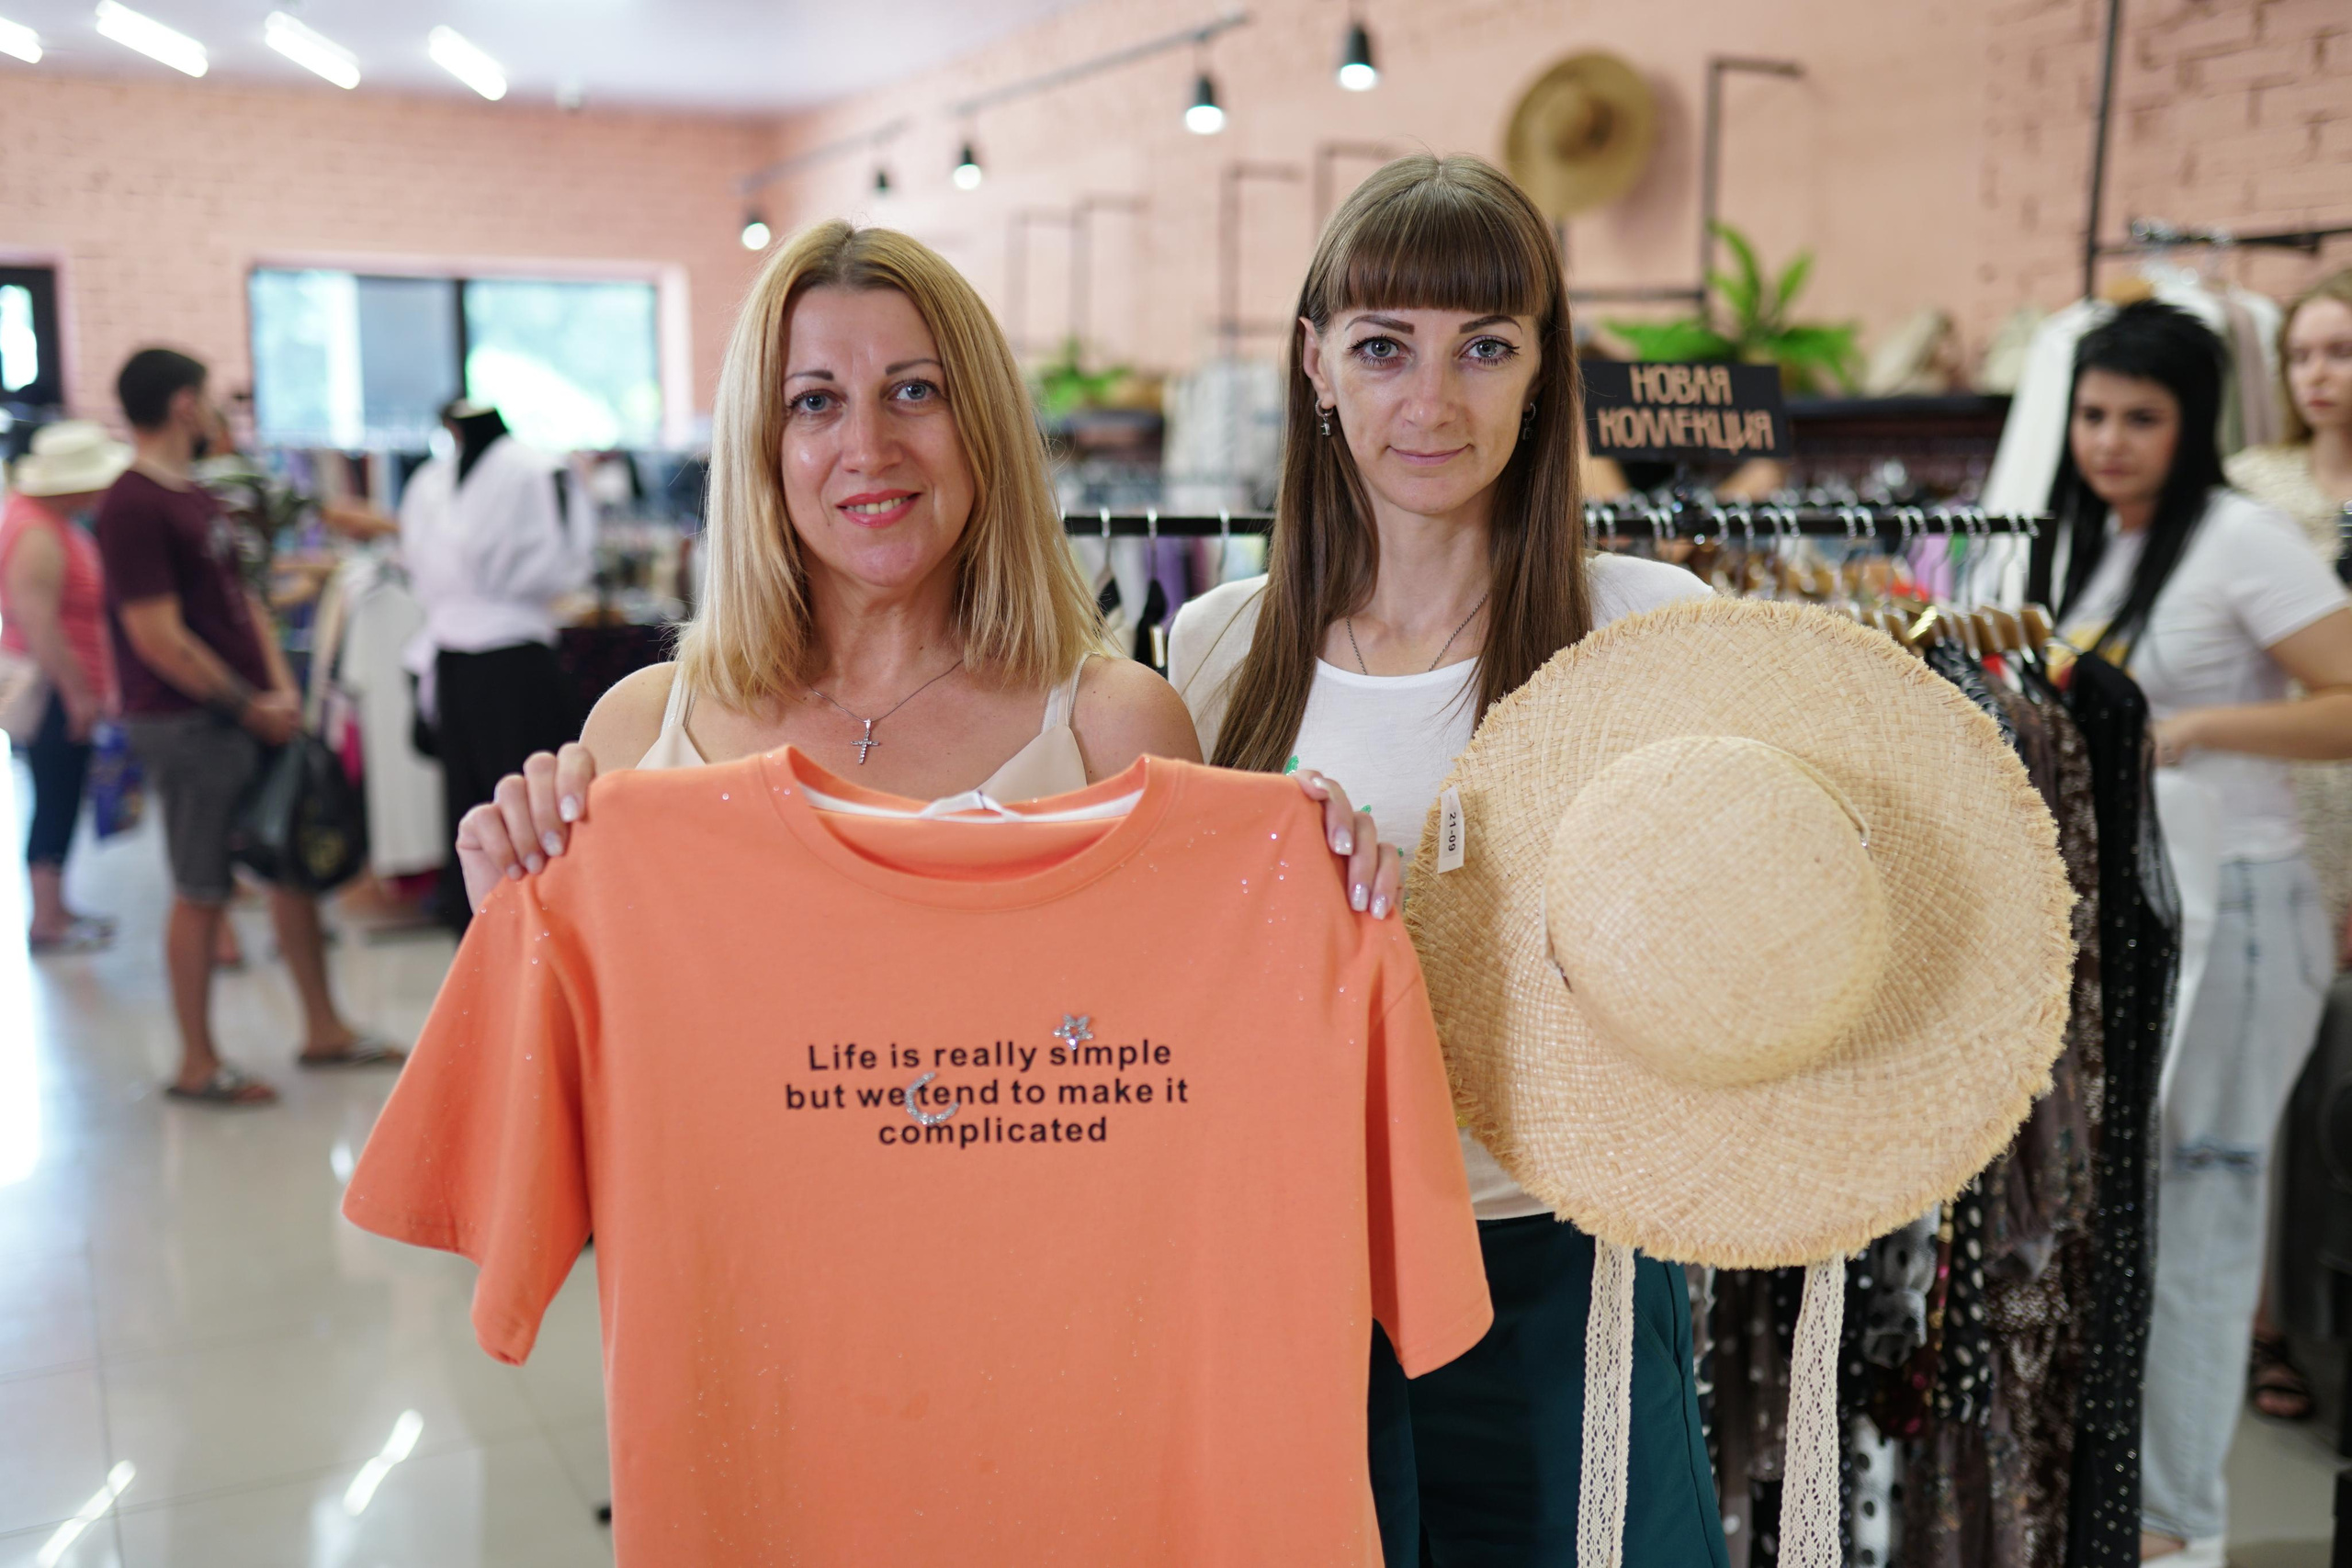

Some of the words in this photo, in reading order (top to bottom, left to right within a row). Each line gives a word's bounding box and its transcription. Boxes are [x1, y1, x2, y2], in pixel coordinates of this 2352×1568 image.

[1629, 364, 1733, 405] НОВАЯ
[1597, 406, 1775, 456] КОЛЛЕКЦИЯ
[1448, 812, 1457, 852] 21-09
[808, 1043, 876, 1071] Life
[890, 1042, 920, 1067] is
[933, 1040, 1037, 1073] really
[1049, 1038, 1170, 1071] simple
[786, 1083, 844, 1110] but
[856, 1086, 906, 1107] we
[917, 1078, 999, 1106] tend
[1012, 1079, 1046, 1104] to
[1058, 1077, 1153, 1104] make
[1166, 1077, 1188, 1103] it
[878, 1116, 1107, 1149] complicated
